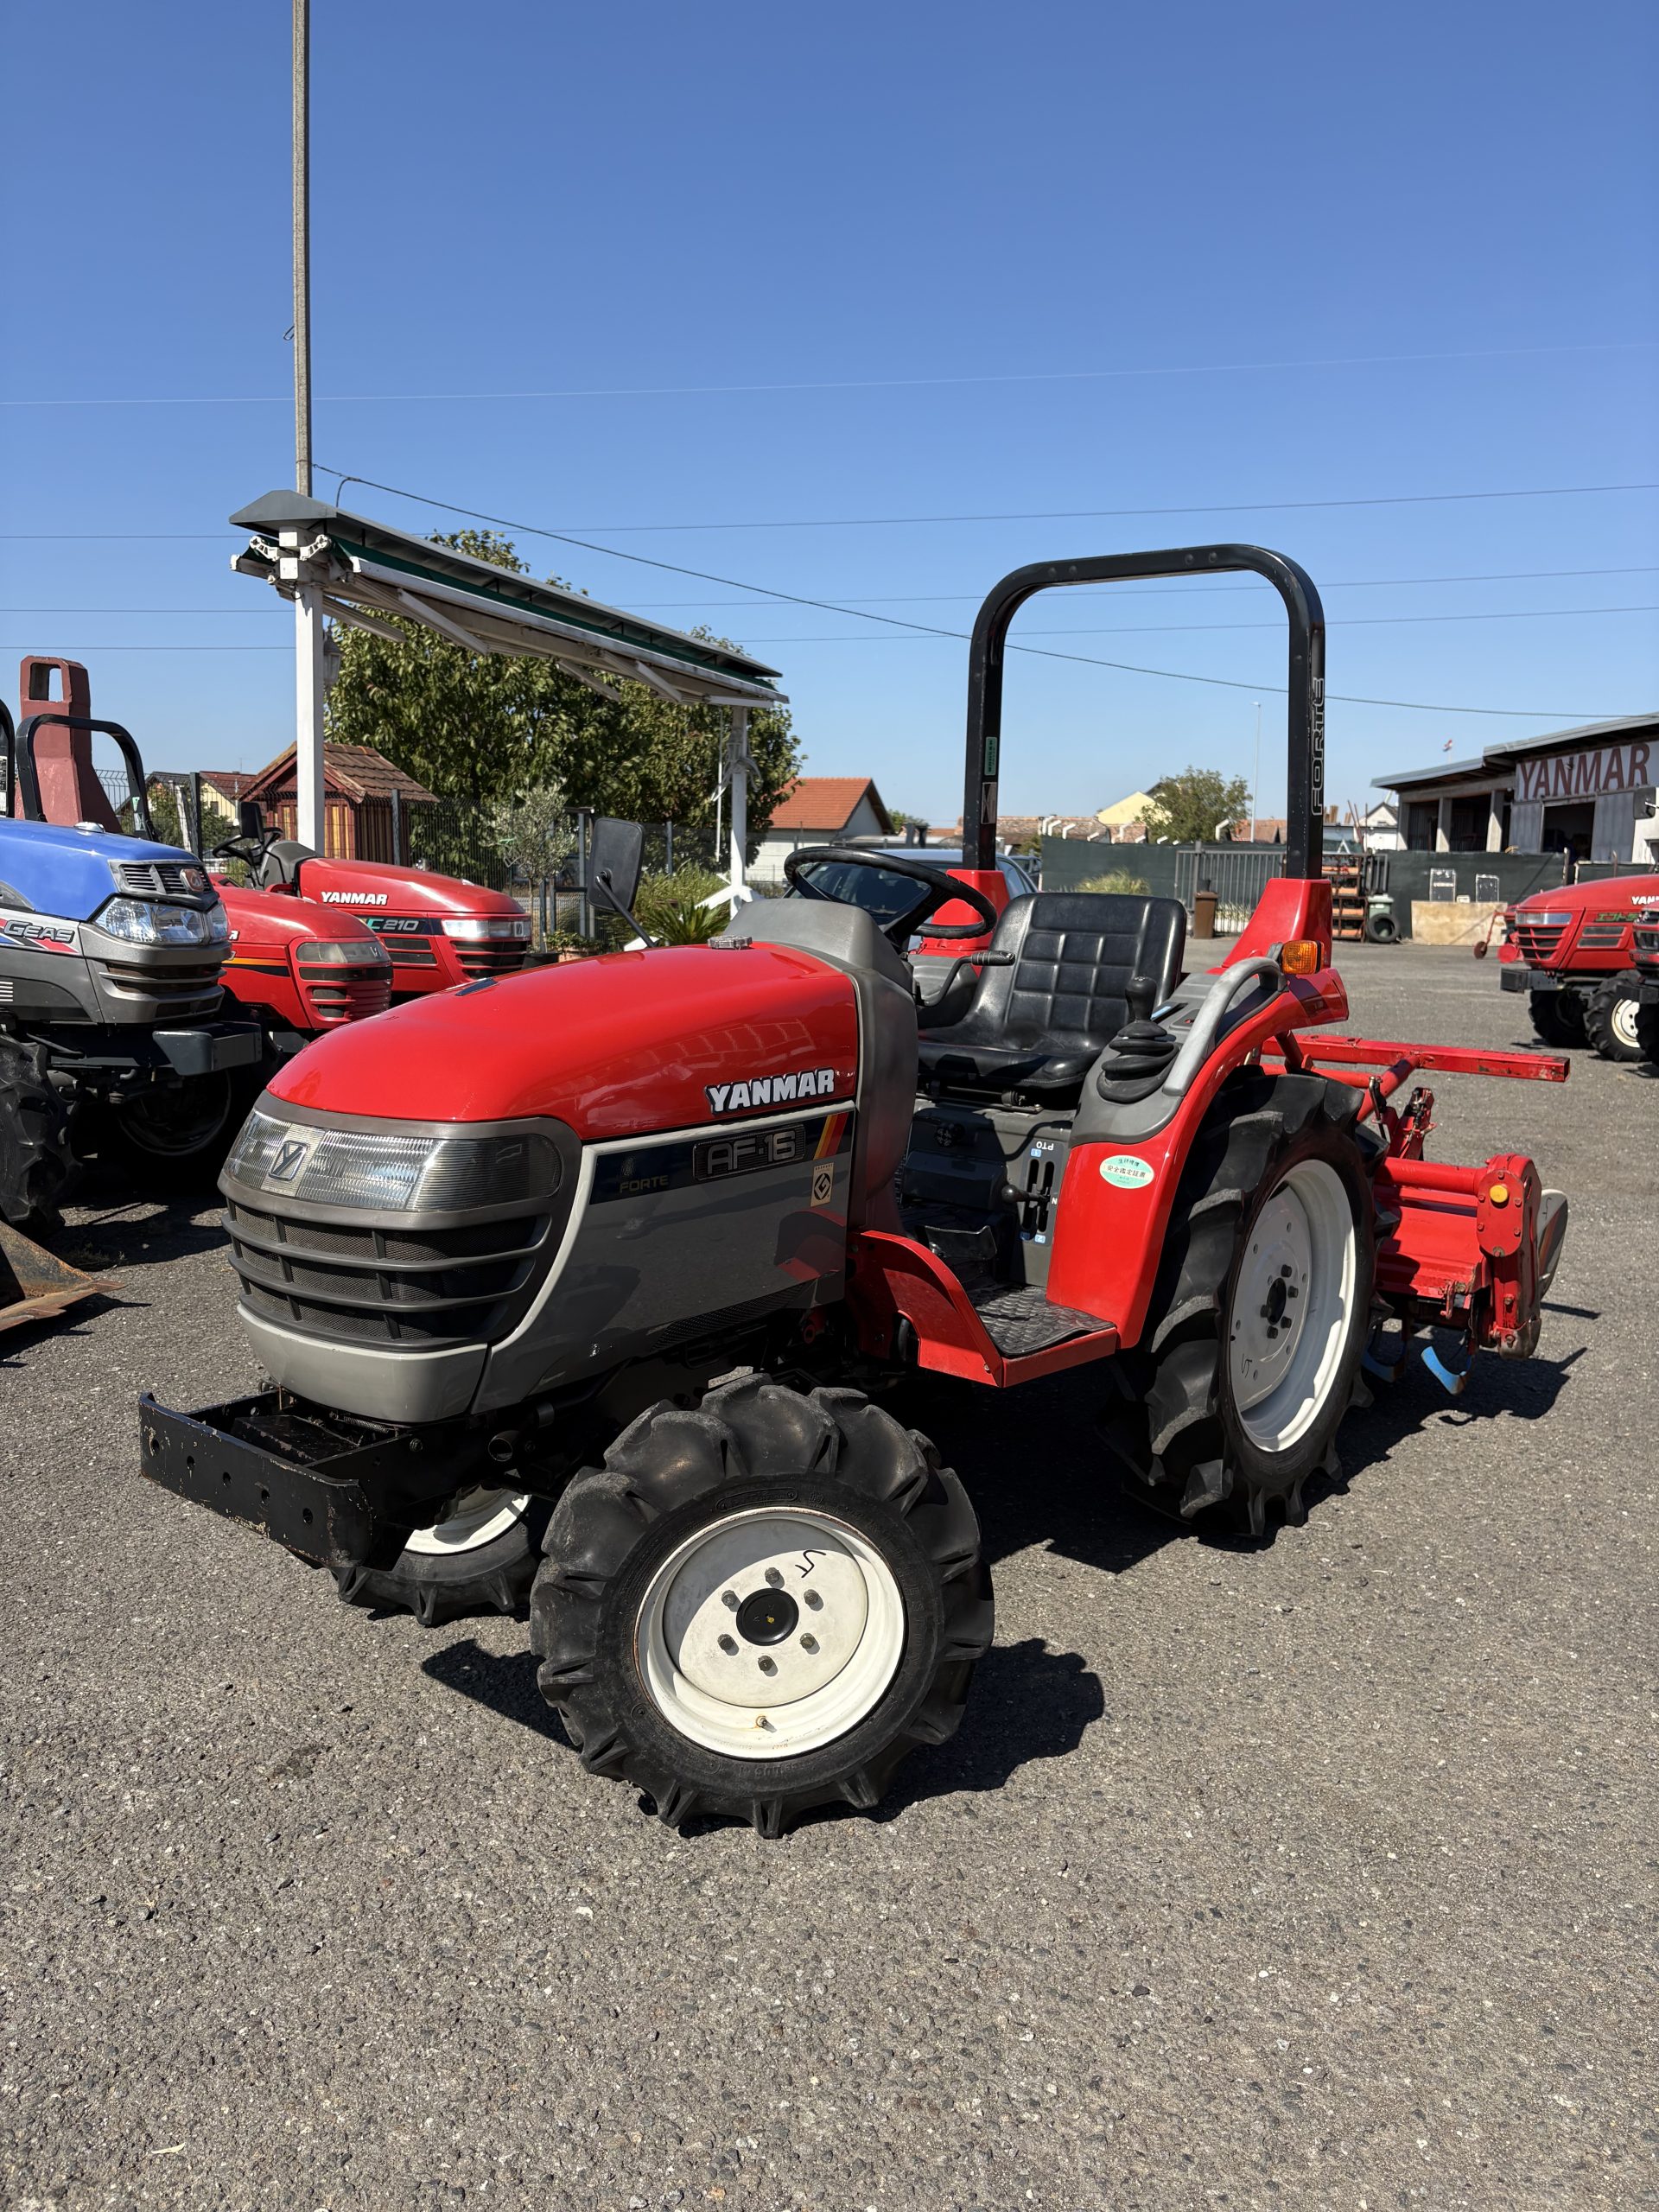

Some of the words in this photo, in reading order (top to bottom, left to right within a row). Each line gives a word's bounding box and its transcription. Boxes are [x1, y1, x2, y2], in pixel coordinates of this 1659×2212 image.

[1311, 677, 1325, 816] FORTE
[1520, 743, 1650, 802] YANMAR
[321, 891, 388, 906] YANMAR
[1630, 895, 1659, 906] YAN
[3, 919, 75, 944] GEAS
[705, 1067, 836, 1114] YANMAR
[1036, 1141, 1054, 1151] PTO
[619, 1175, 670, 1193] FORTE
